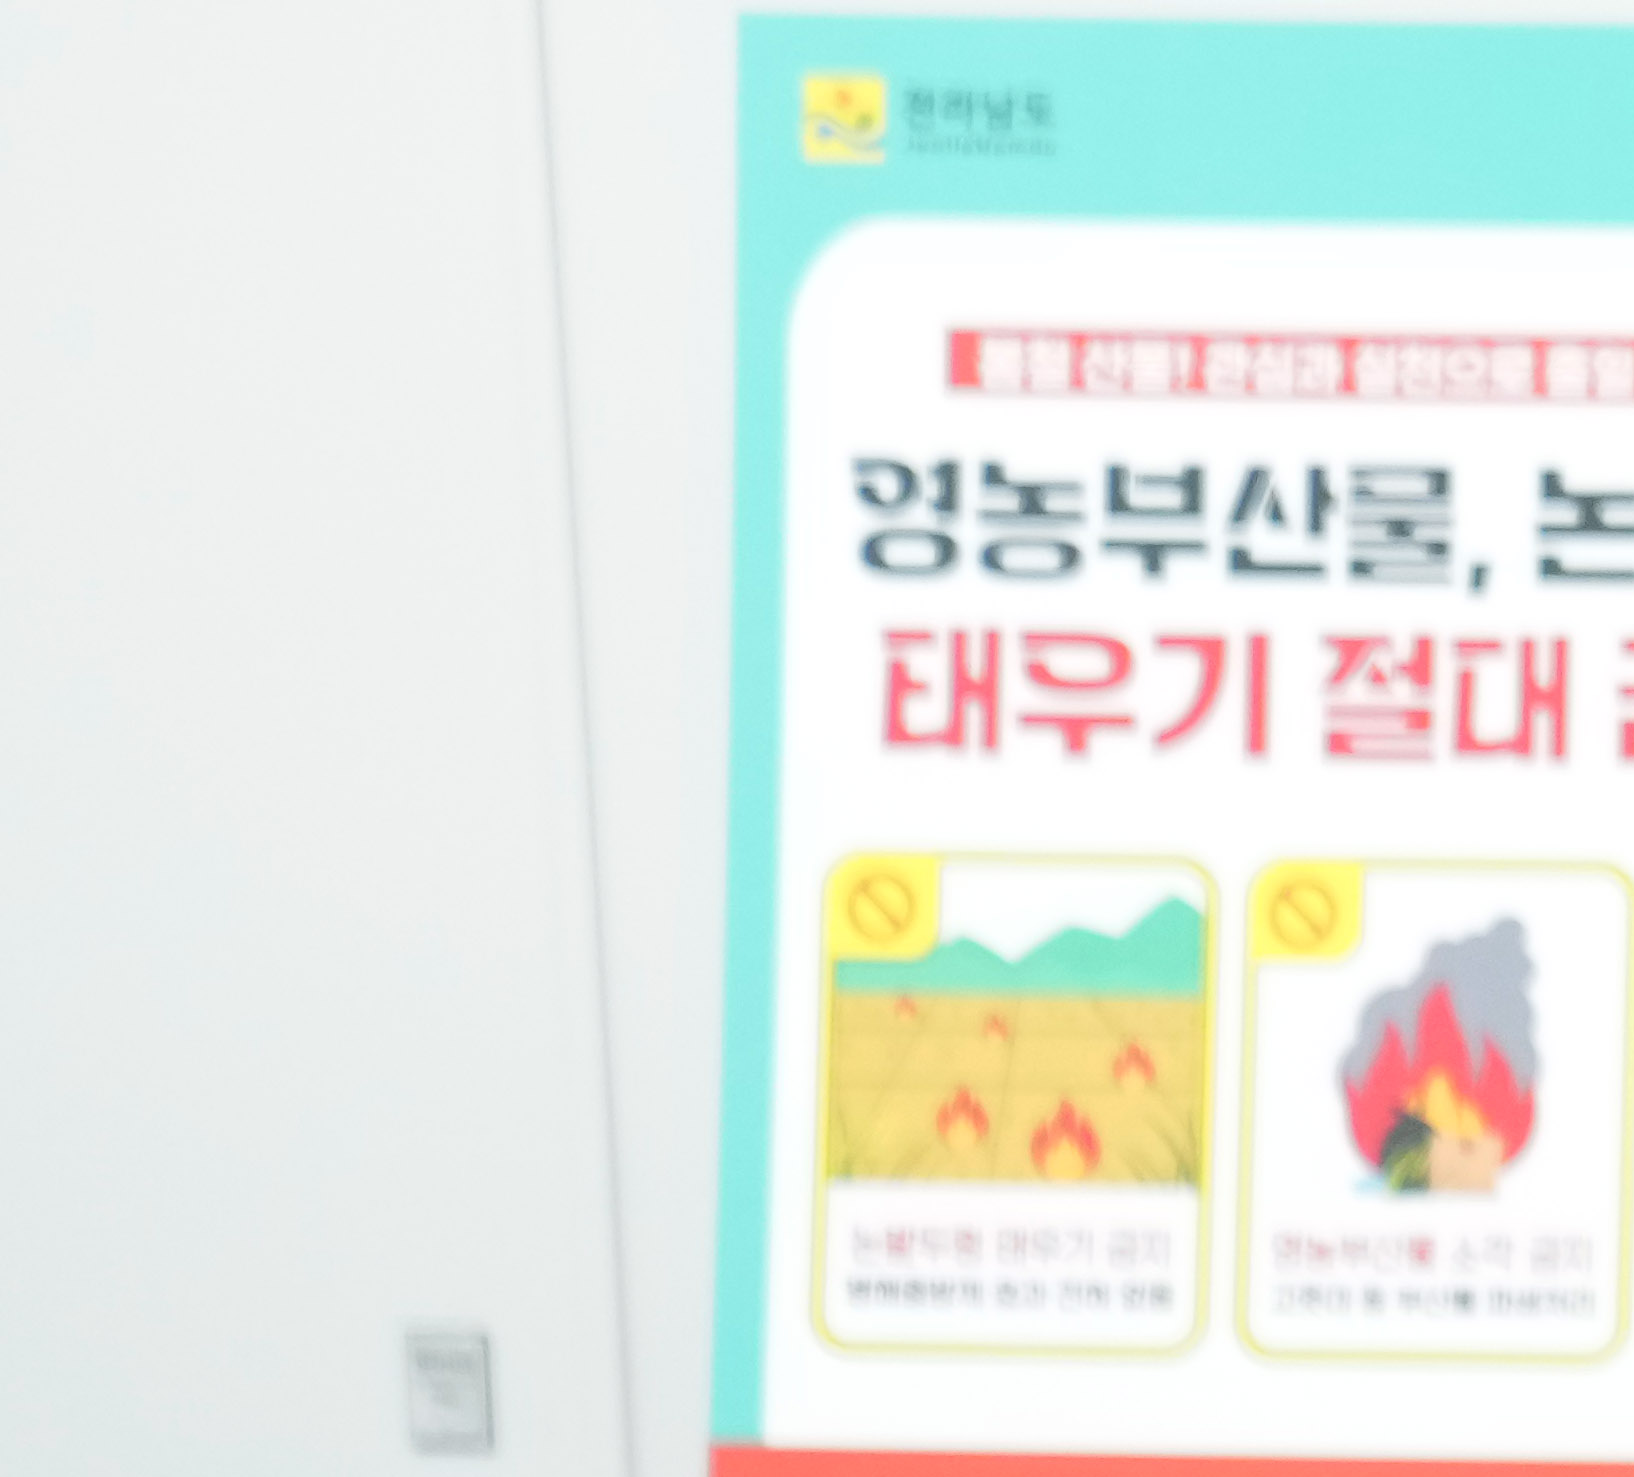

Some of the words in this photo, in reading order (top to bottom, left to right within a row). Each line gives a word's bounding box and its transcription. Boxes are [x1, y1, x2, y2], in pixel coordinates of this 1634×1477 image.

[852, 457, 1497, 595] 영농부산물,
[880, 628, 1274, 760] 태우기
[1321, 632, 1572, 763] 절대
